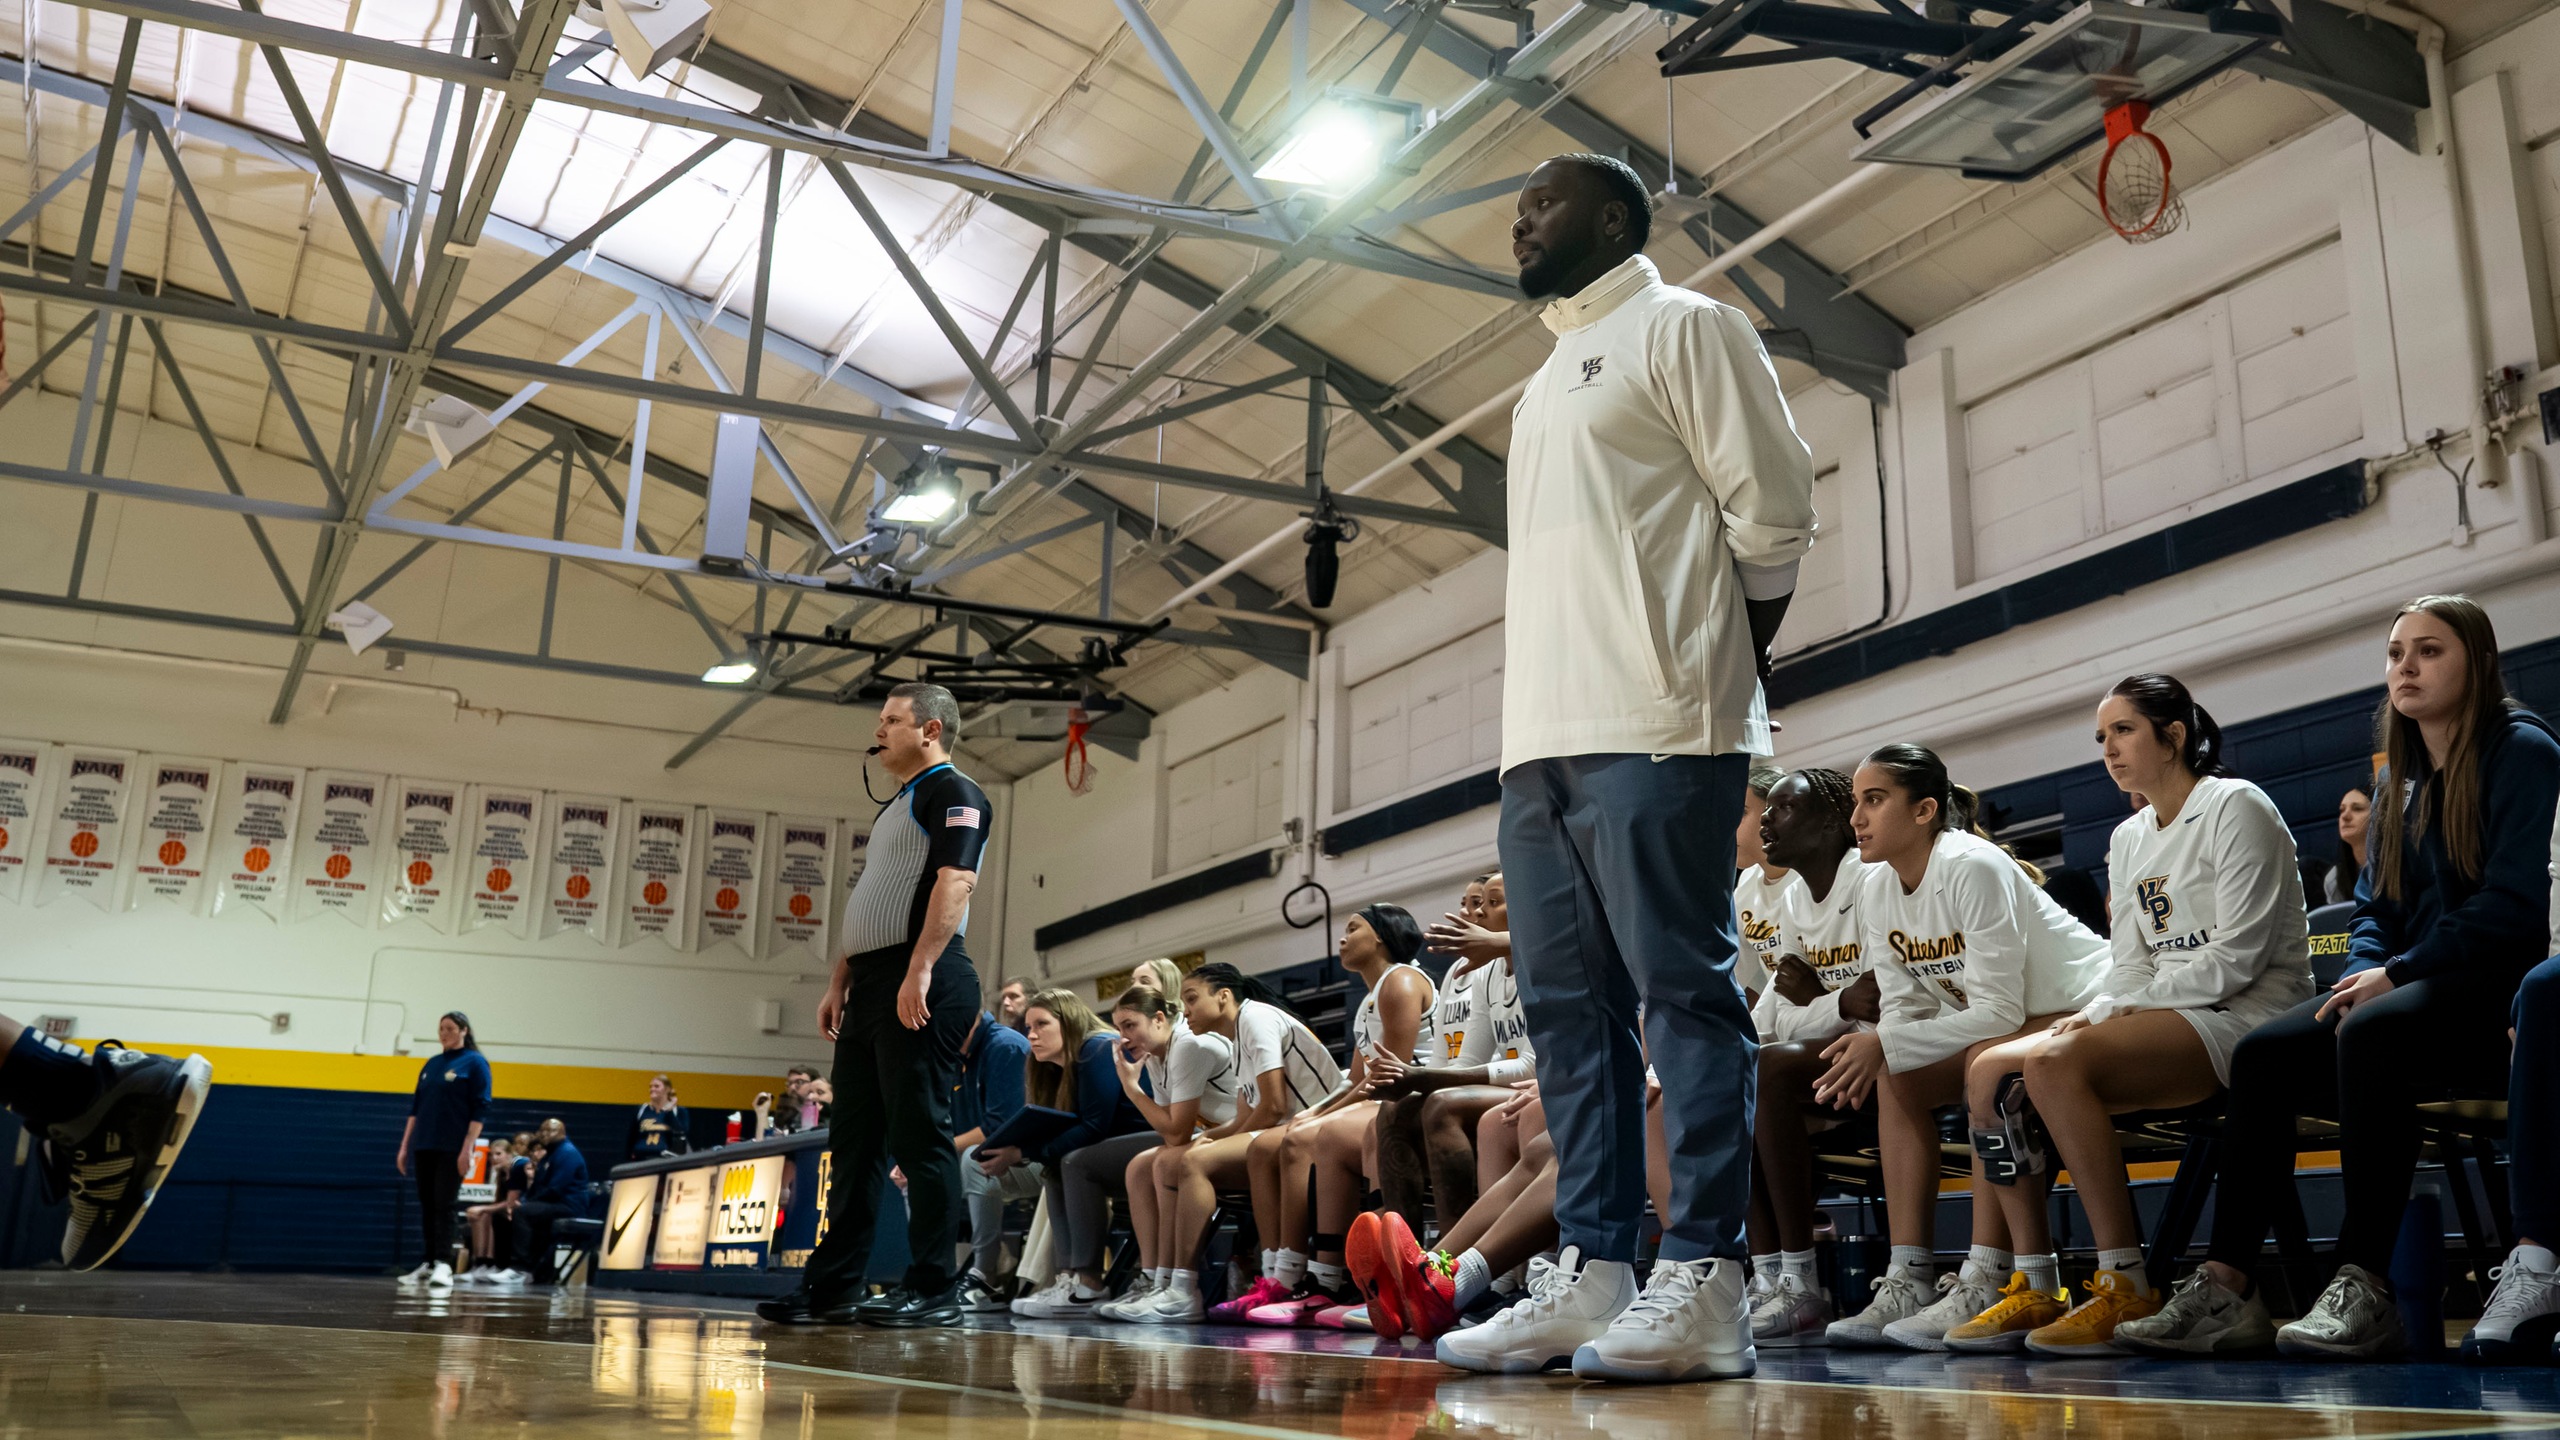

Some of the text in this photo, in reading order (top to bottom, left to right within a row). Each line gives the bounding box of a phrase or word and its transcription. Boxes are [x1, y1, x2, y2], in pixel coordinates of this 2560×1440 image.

[1581, 355, 1606, 384] WP
[0, 754, 36, 776] AIA
[71, 760, 124, 783] NAIA
[157, 770, 209, 792] NAIA
[243, 777, 294, 800] NAIA
[324, 784, 374, 807] NAIA
[405, 792, 453, 815] NAIA
[485, 799, 532, 821] NAIA
[562, 807, 608, 829] NAIA
[2136, 874, 2173, 934] WP
